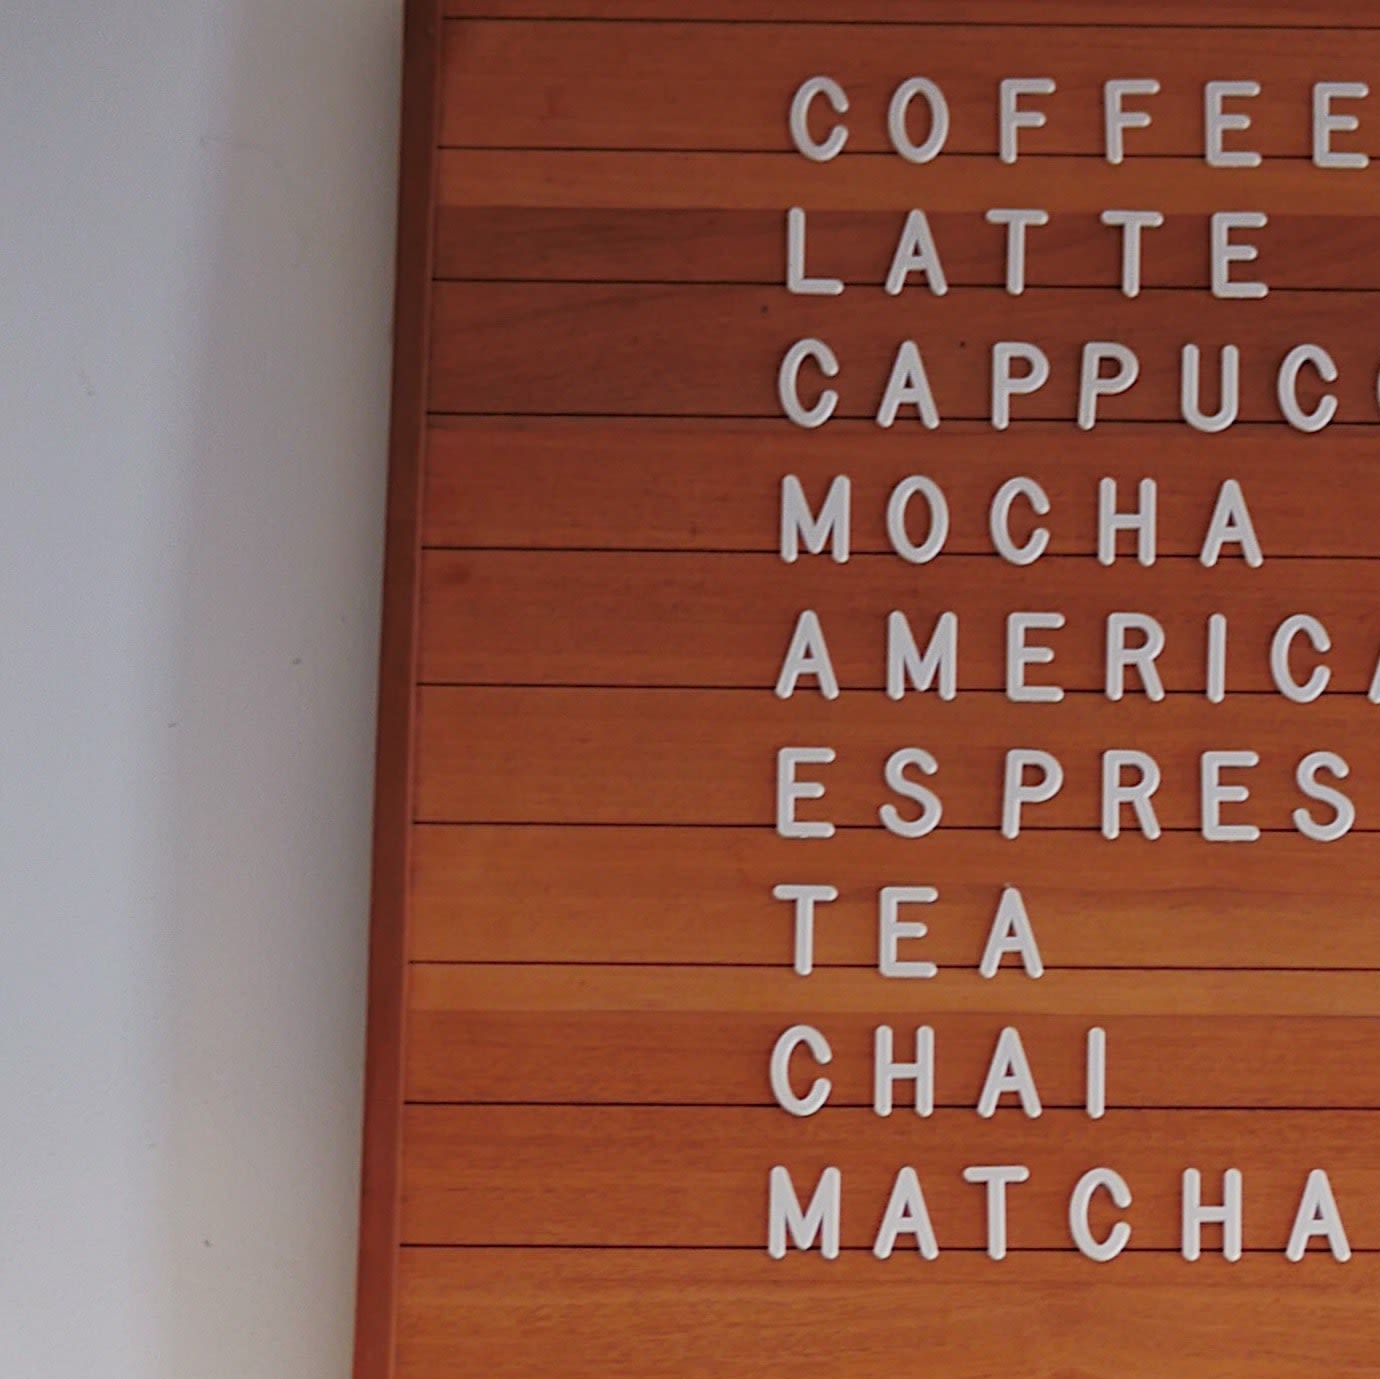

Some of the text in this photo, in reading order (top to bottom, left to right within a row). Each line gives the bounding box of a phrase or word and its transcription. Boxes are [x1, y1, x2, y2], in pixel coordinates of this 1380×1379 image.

[790, 76, 1369, 169] COFFEE
[788, 207, 1269, 298] LATTE
[780, 474, 1264, 568] MOCHA
[772, 884, 1045, 979] TEA
[769, 1024, 1106, 1119] CHAI
[767, 1165, 1352, 1262] MATCHA
